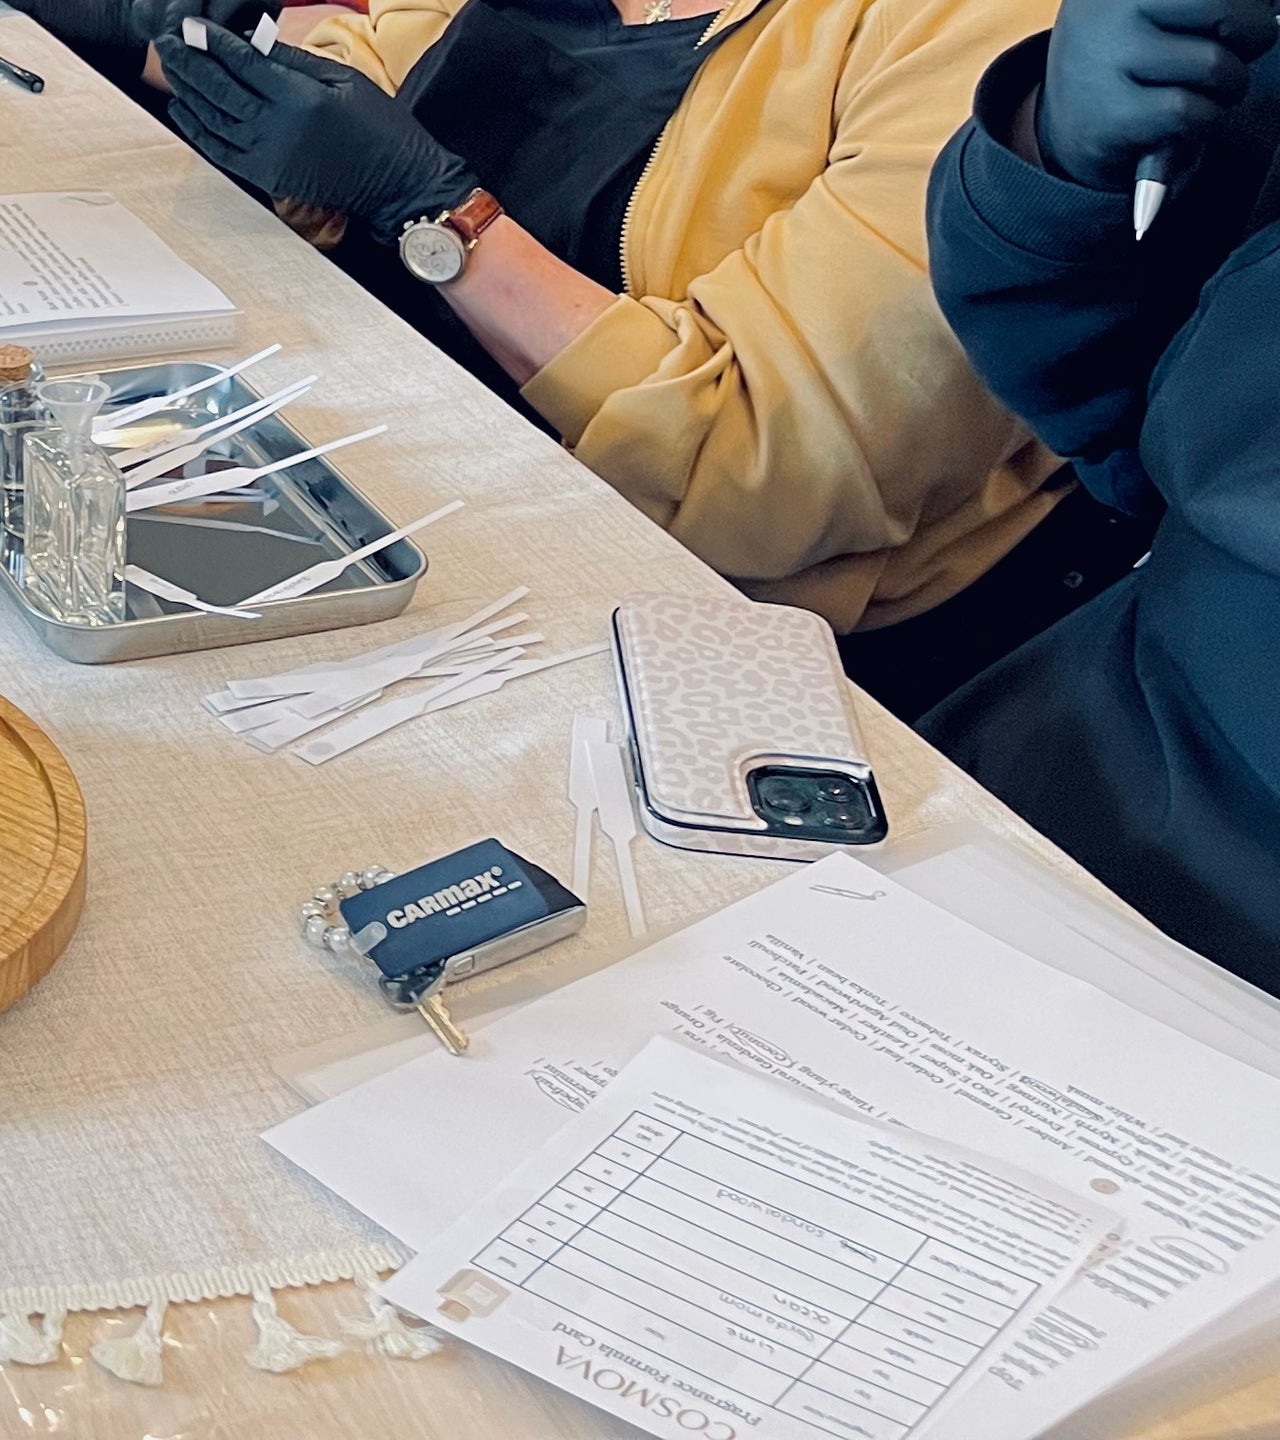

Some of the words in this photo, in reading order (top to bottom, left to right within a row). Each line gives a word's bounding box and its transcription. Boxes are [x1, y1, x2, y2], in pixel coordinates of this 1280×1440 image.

[551, 1321, 595, 1346] Card
[598, 1343, 669, 1383] Formula
[672, 1380, 761, 1425] Fragrance
